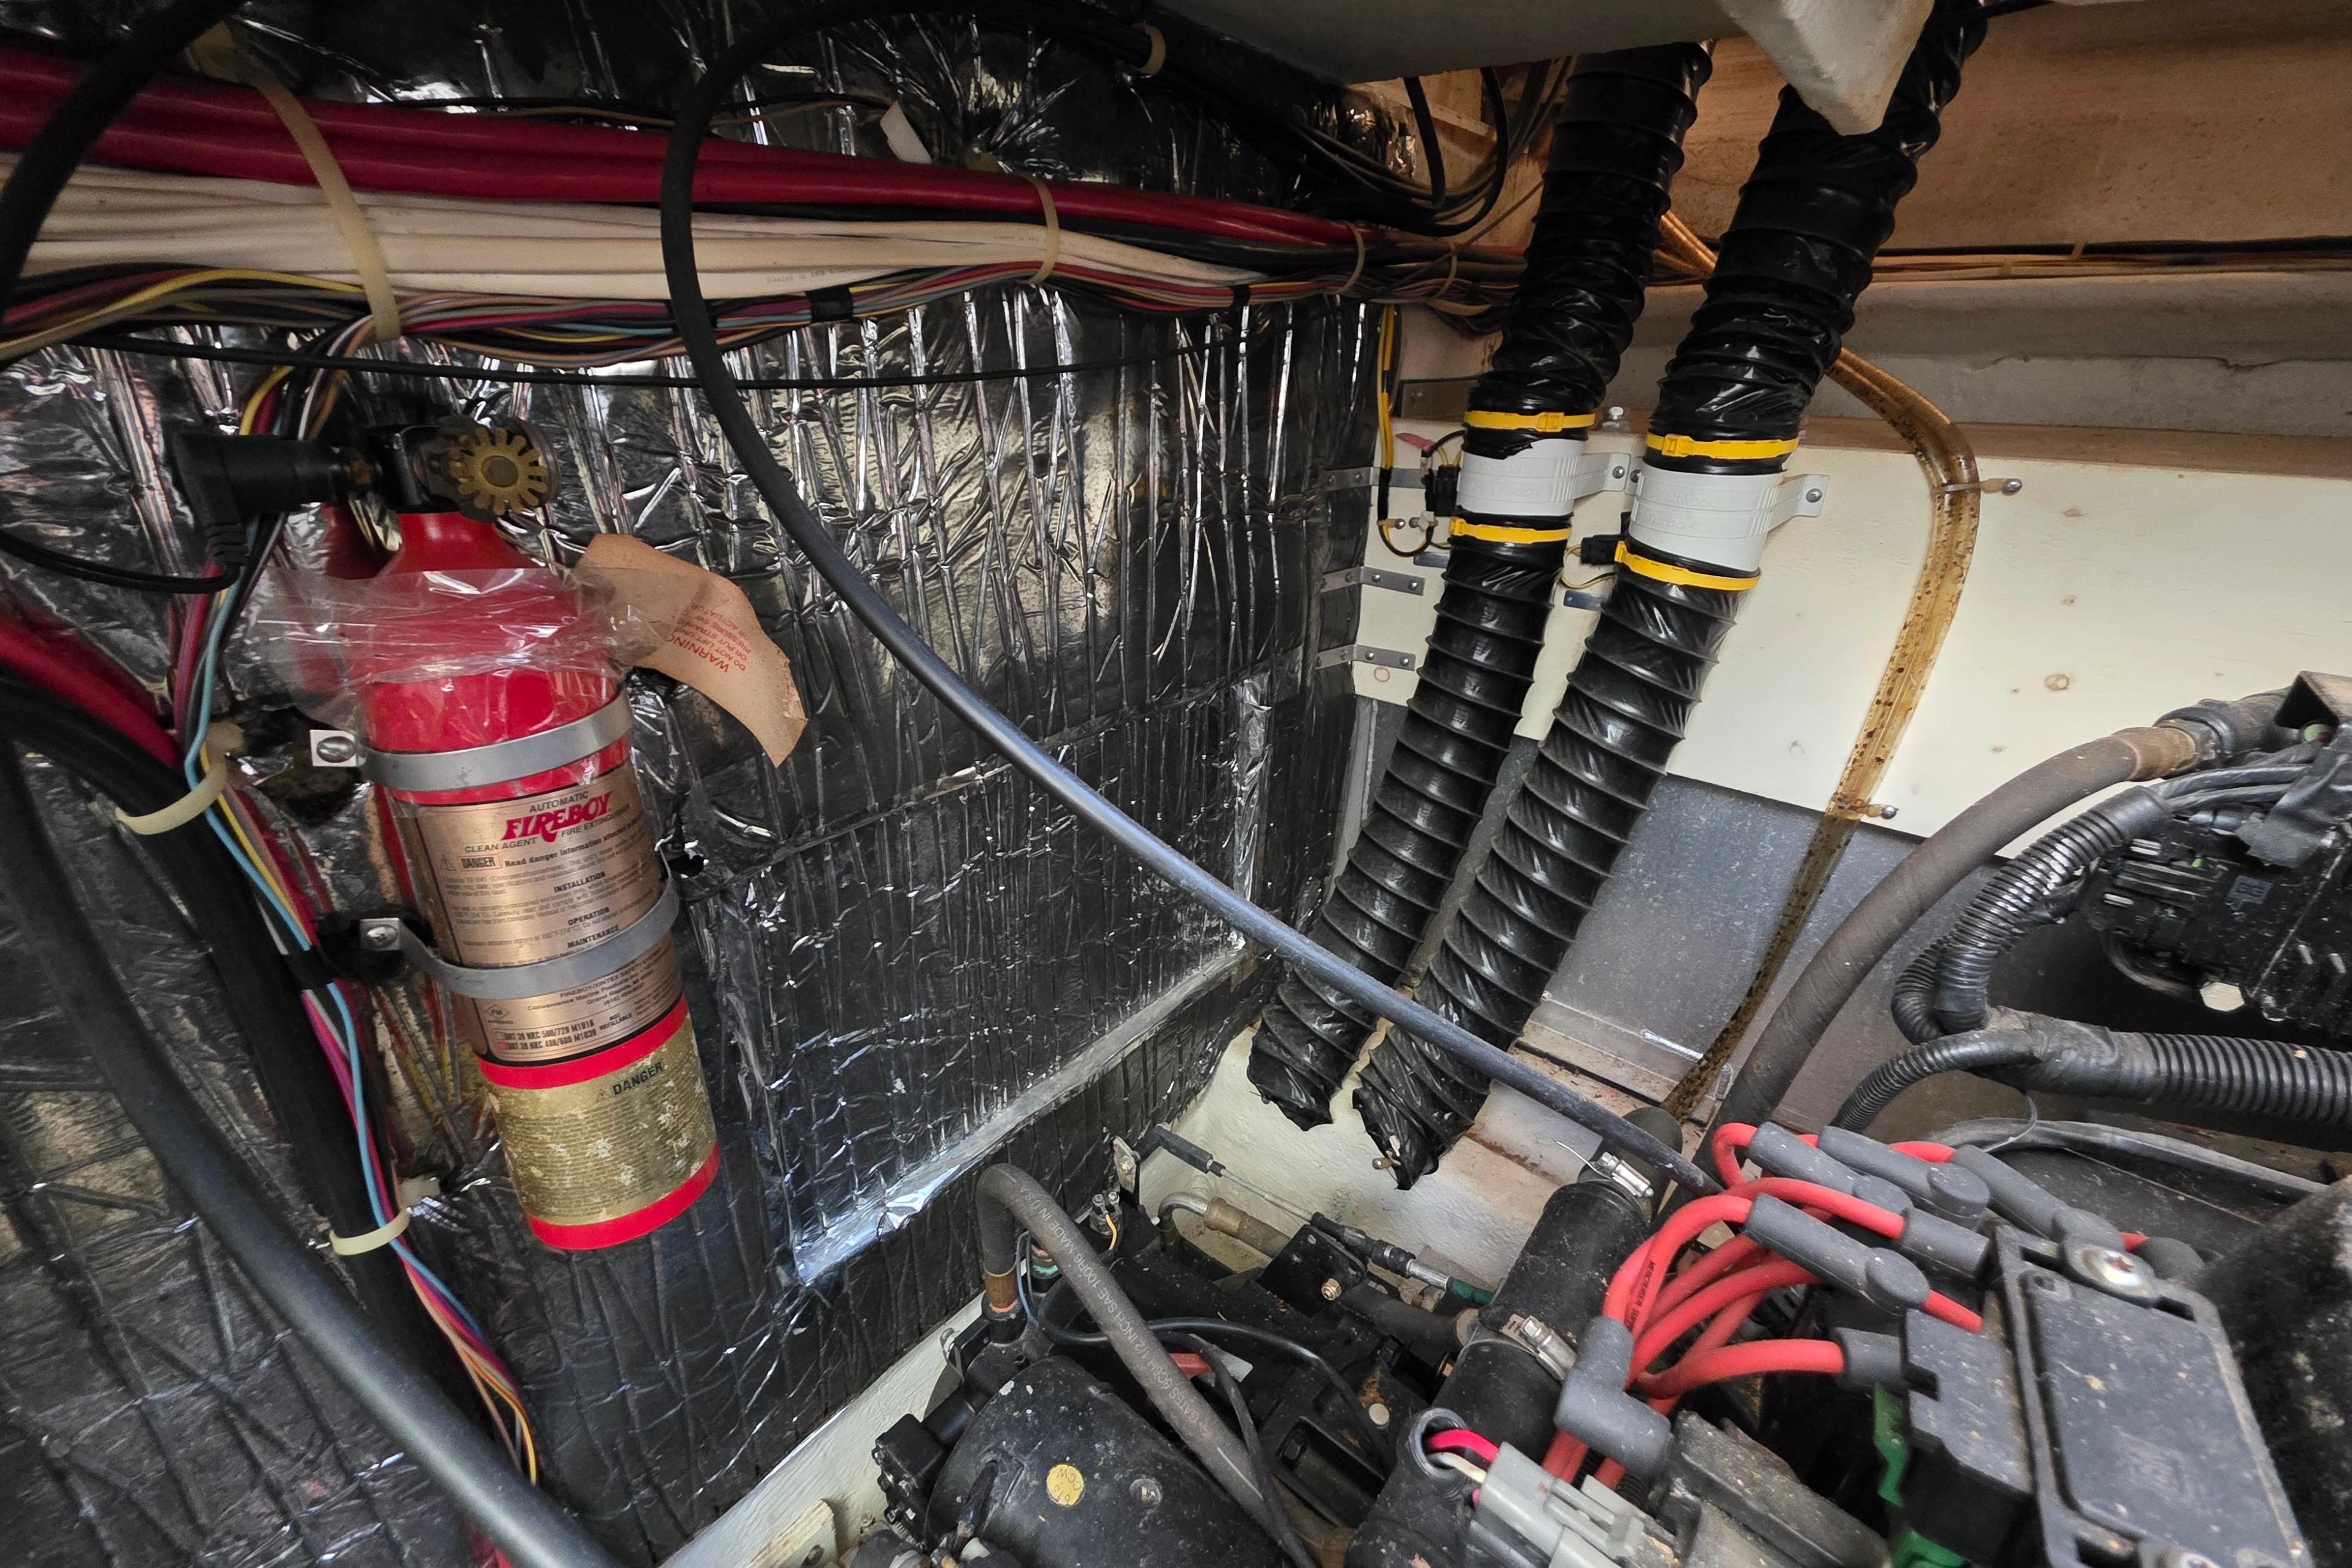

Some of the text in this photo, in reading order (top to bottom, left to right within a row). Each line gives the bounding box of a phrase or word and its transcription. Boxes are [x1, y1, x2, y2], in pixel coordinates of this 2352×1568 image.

[686, 621, 717, 639] STRAIN
[711, 621, 751, 654] PRESSURE
[739, 629, 750, 641] OR
[696, 636, 714, 648] LIFT
[717, 638, 734, 651] PUT
[715, 647, 733, 661] NOT
[733, 659, 746, 671] DO
[736, 650, 747, 661] OR
[530, 791, 589, 813] AUTOMATIC
[501, 791, 613, 842] FIREBOY
[465, 843, 499, 852] CLEAN
[502, 837, 537, 849] AGENT
[562, 825, 581, 837] FIRE
[461, 857, 495, 868] DANGER
[505, 858, 526, 867] Read
[529, 852, 557, 863] danger
[560, 838, 602, 856] information
[553, 871, 606, 892] INSTALLATION
[568, 907, 609, 925] OPERATION
[567, 924, 619, 948] MAINTENANCE
[576, 991, 599, 1001] Marine
[613, 1061, 663, 1095] DANGER
[1038, 1208, 1052, 1222] IN
[1048, 1220, 1077, 1254] MADE
[1074, 1253, 1101, 1288] 100R6
[1635, 1259, 1656, 1306] MERCRUISER
[1097, 1288, 1118, 1313] SAE
[1114, 1311, 1138, 1343] INCH
[1135, 1343, 1150, 1360] 1/2
[1170, 1387, 1200, 1423] GATES
[1057, 1468, 1082, 1491] CCW
